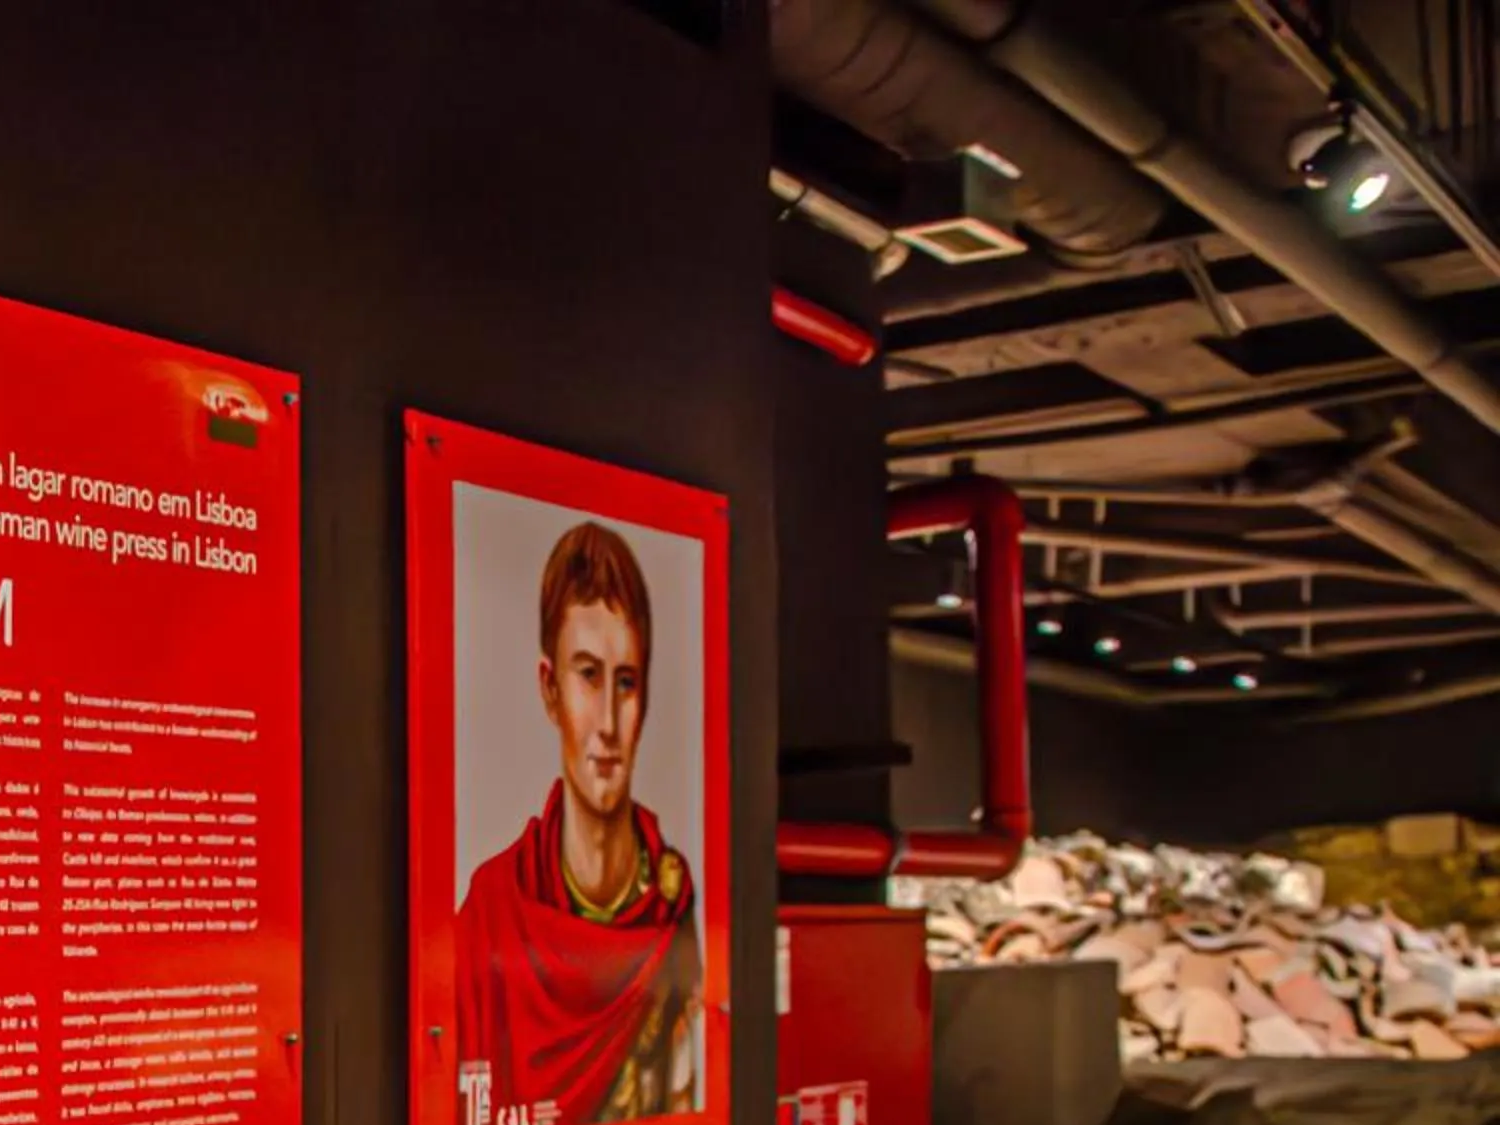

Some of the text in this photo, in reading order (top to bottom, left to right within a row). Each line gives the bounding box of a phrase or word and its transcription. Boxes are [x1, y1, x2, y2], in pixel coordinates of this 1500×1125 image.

[9, 452, 65, 501] lagar
[71, 476, 153, 512] romano
[158, 493, 191, 519] em
[195, 490, 258, 531] Lisboa
[55, 515, 107, 551] wine
[112, 532, 167, 565] press
[172, 532, 190, 565] in
[195, 536, 258, 575] Lisbon
